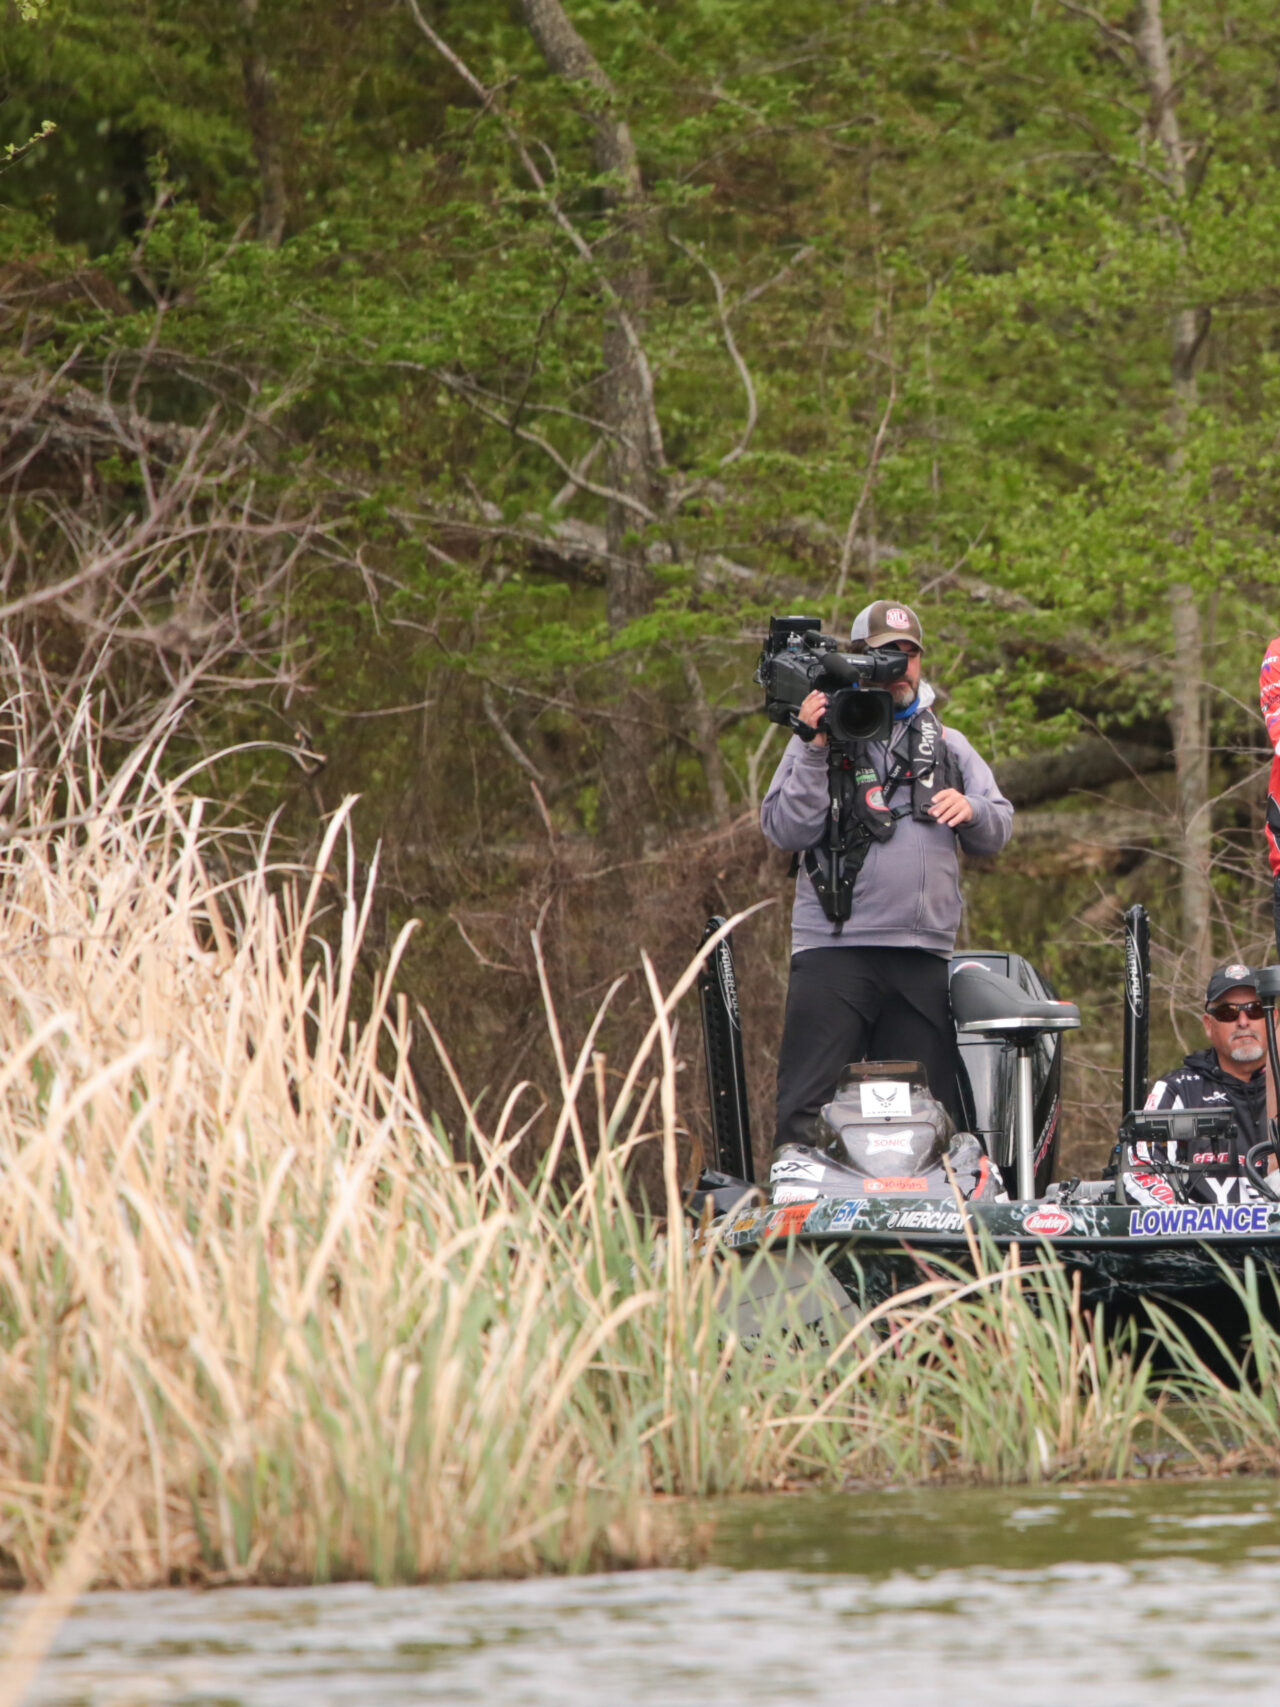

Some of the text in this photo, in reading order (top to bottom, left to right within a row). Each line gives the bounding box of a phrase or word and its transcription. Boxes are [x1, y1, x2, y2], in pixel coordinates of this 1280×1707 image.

[918, 720, 937, 756] Onyx
[873, 1138, 906, 1148] SONIC
[896, 1211, 972, 1231] MERCURY
[1028, 1213, 1068, 1233] Berkley
[1130, 1206, 1269, 1236] LOWRANCE
